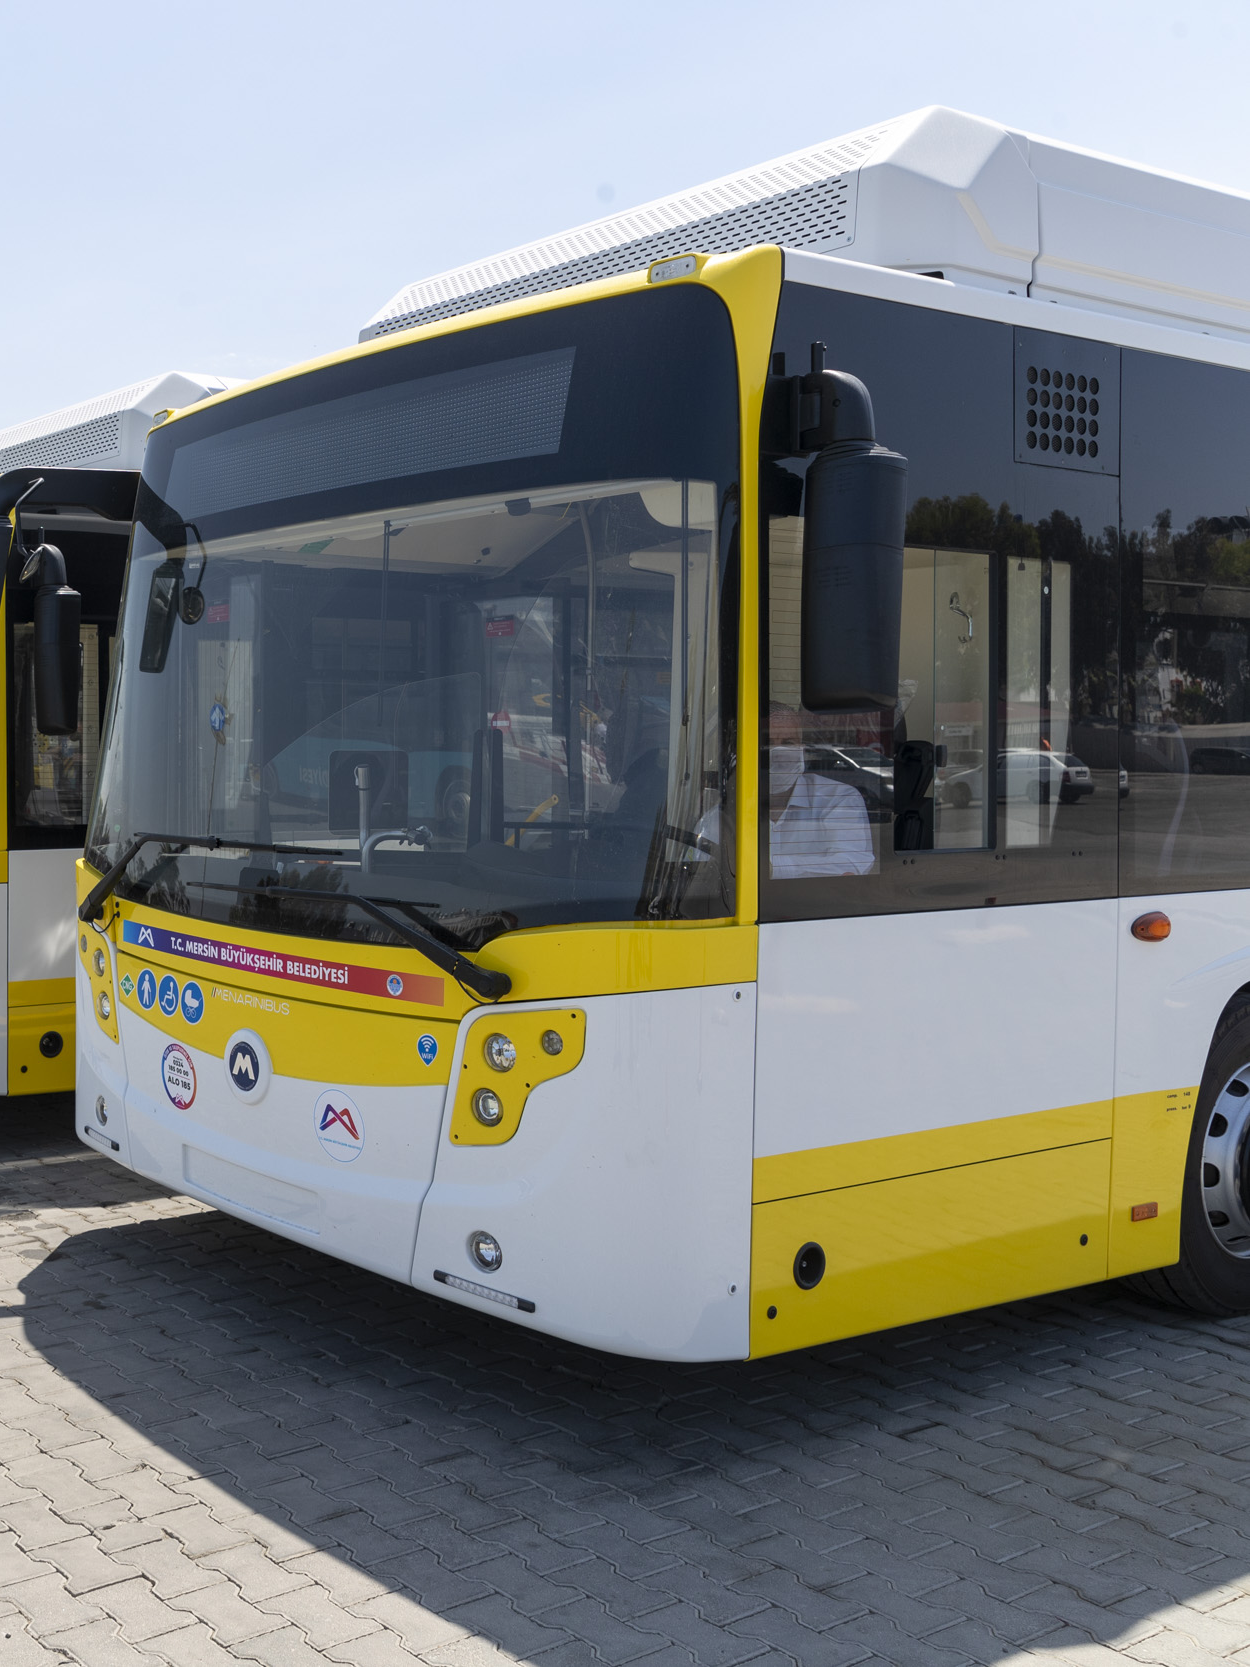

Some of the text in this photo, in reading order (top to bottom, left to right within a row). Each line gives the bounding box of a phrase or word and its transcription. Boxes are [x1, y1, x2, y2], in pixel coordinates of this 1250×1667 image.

[170, 936, 349, 985] T.C. MERSİN BÜYÜKŞEHİR BELEDİYESİ
[121, 980, 134, 991] CNG
[214, 987, 290, 1016] MENARINIBUS
[167, 1075, 191, 1091] ALO 185
